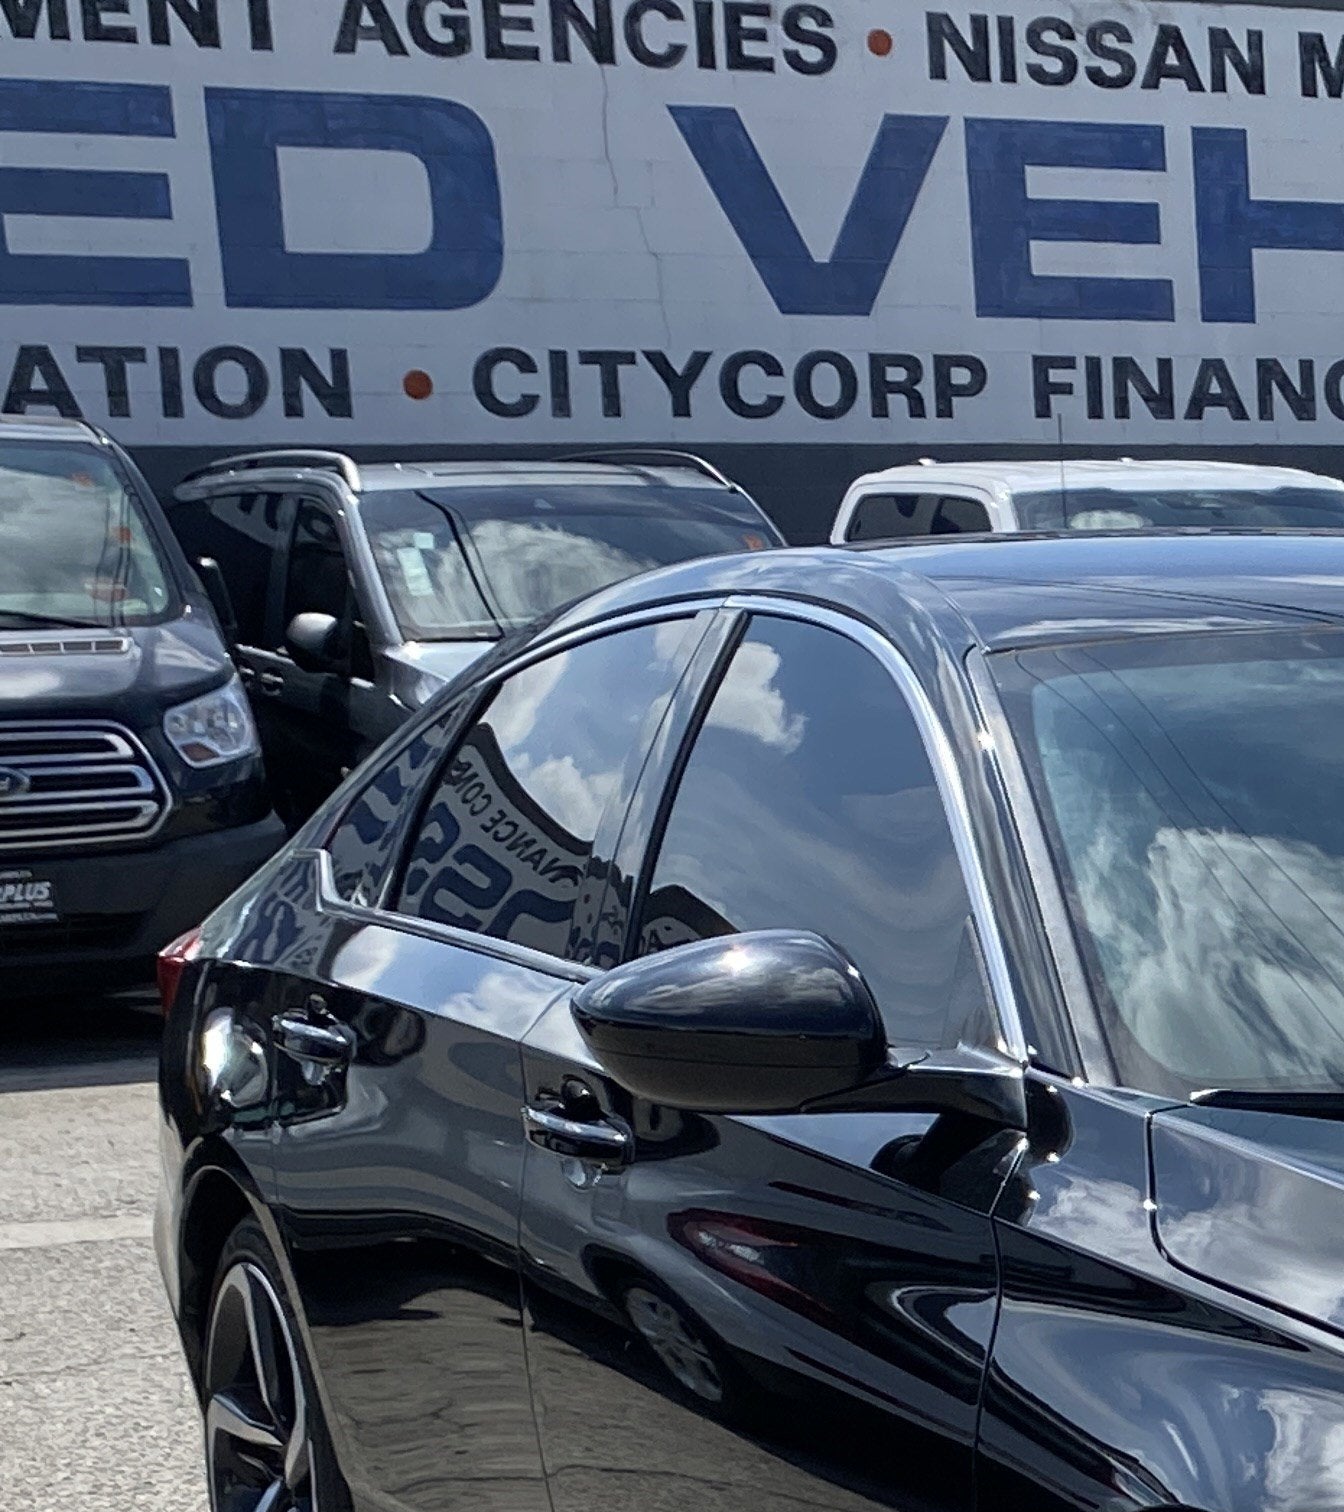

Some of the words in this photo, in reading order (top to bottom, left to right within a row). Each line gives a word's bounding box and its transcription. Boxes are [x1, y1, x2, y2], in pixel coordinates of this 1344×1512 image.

[334, 0, 839, 76] AGENCIES
[927, 10, 1267, 96] NISSAN
[0, 78, 504, 309] ED
[2, 344, 353, 420] ATION
[472, 349, 988, 420] CITYCORP
